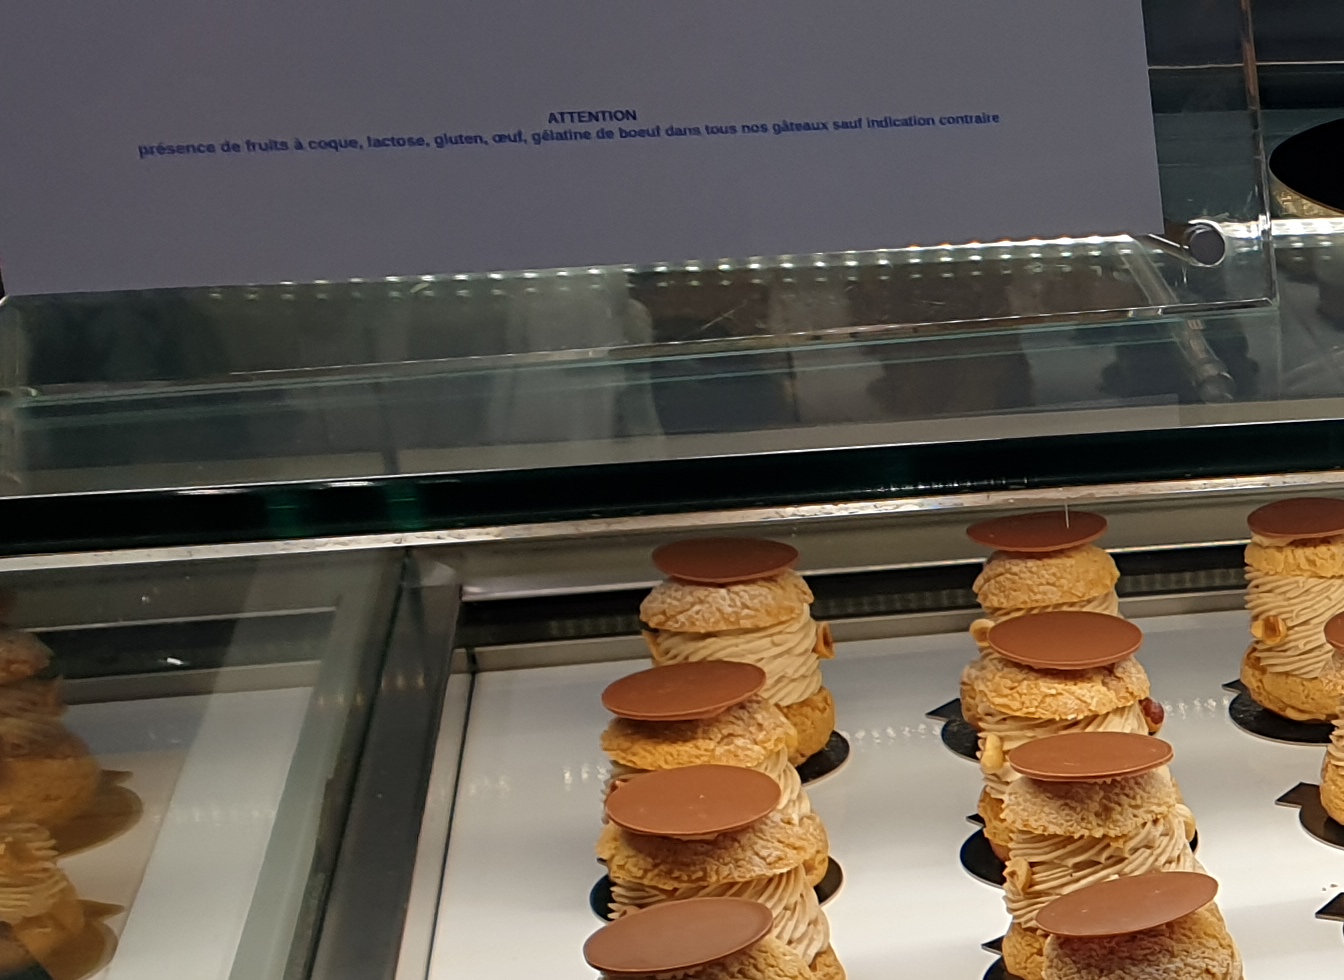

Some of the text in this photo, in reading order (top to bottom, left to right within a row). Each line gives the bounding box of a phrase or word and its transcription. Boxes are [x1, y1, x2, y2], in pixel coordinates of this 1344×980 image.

[548, 110, 636, 123] ATTENTION
[138, 142, 216, 159] présence
[221, 141, 240, 152] de
[245, 139, 288, 152] fruits
[294, 138, 304, 150] à
[308, 138, 362, 152] coque,
[368, 135, 430, 148] lactose,
[434, 132, 488, 148] gluten,
[532, 129, 591, 145] gélatine
[596, 128, 614, 139] de
[620, 126, 660, 138] boeuf
[665, 126, 700, 137] dans
[705, 124, 737, 136] tous
[742, 124, 768, 134] nos
[772, 120, 828, 136] gâteaux
[832, 118, 862, 130] sauf
[867, 116, 935, 129] indication
[939, 112, 1000, 125] contraire
